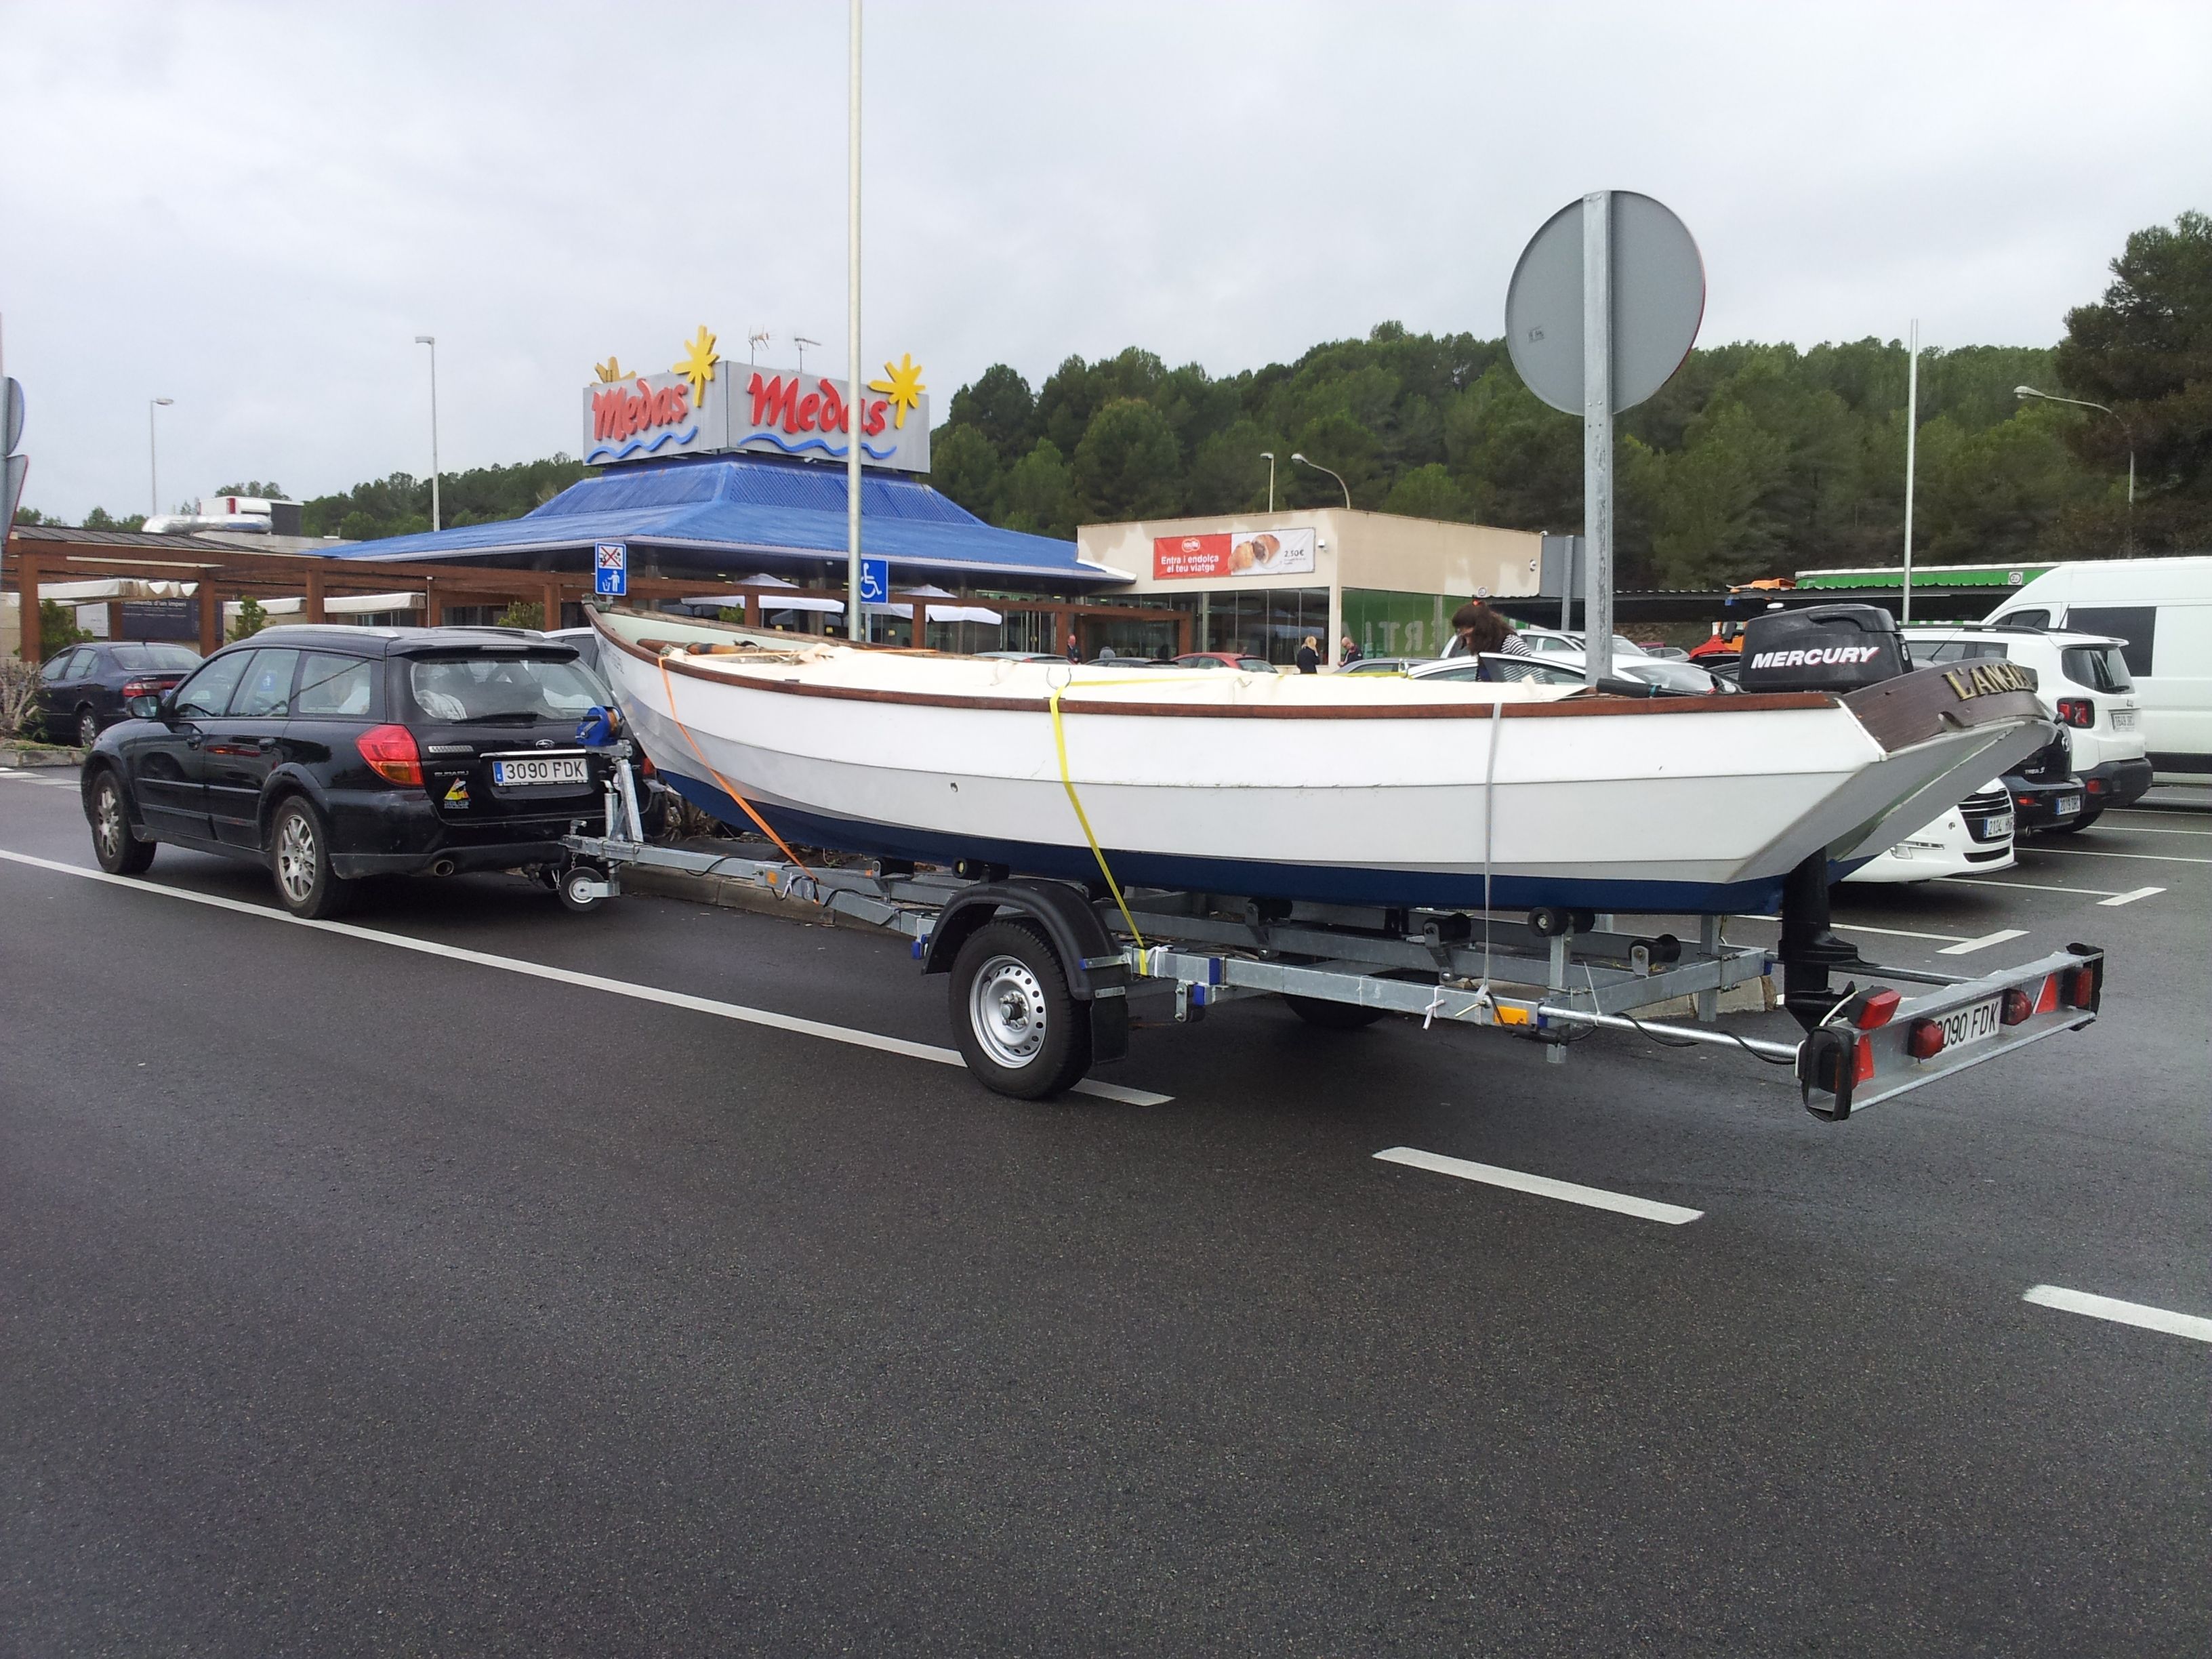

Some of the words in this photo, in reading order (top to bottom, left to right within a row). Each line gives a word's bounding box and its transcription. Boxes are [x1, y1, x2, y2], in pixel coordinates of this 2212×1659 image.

[592, 377, 689, 442] Medas
[747, 371, 889, 436] Medas
[1161, 556, 1181, 565] Entra
[1183, 554, 1186, 564] i
[1187, 553, 1219, 564] endolça
[1166, 564, 1174, 573] el
[1175, 564, 1189, 573] teu
[1190, 562, 1215, 573] viatge
[1750, 646, 1880, 670] MERCURY
[1902, 644, 1909, 661] 6
[505, 762, 548, 780] 3090
[552, 760, 584, 779] FDK
[1970, 1001, 1999, 1039] FDK
